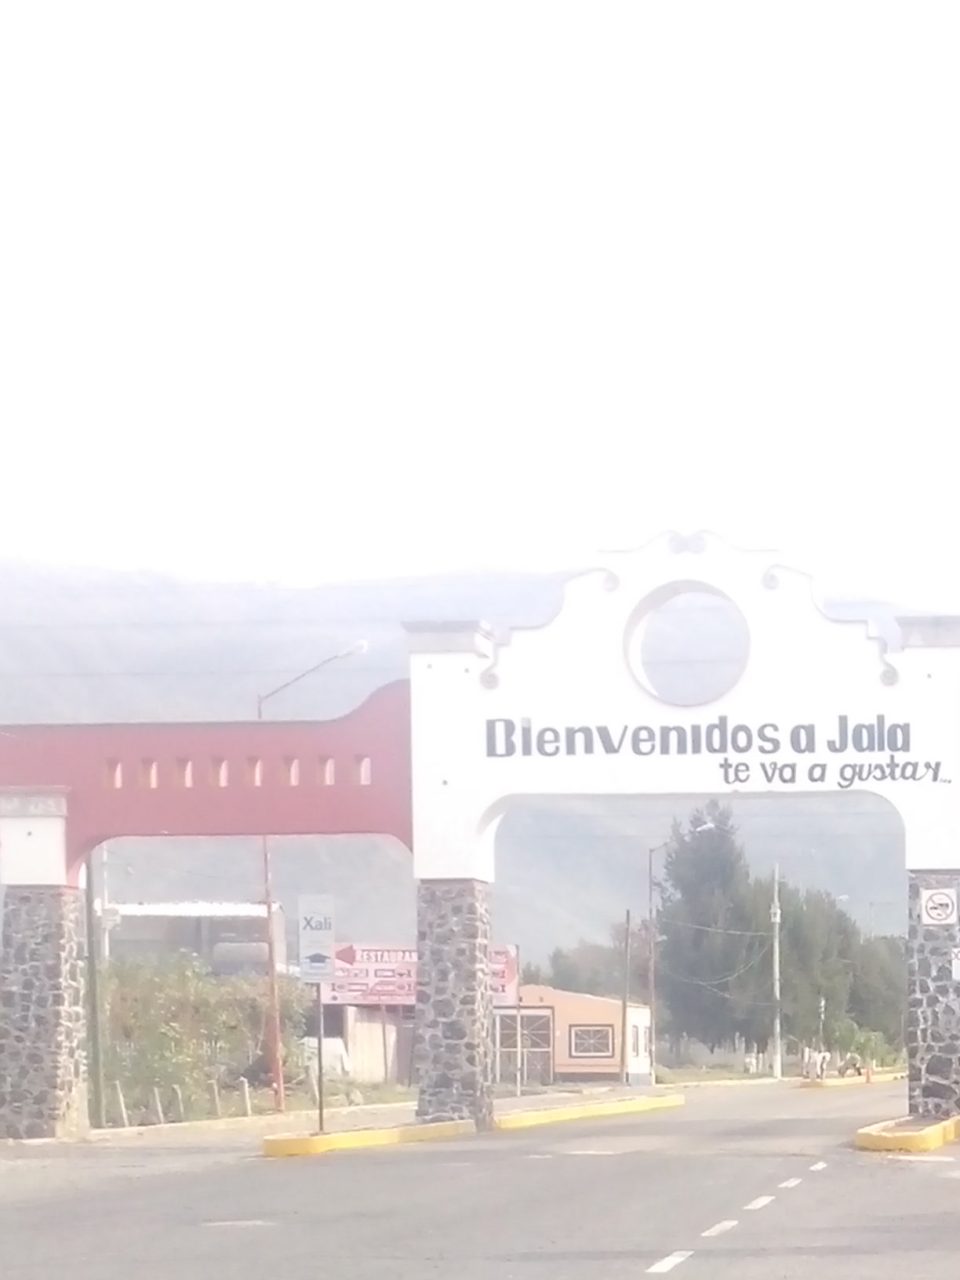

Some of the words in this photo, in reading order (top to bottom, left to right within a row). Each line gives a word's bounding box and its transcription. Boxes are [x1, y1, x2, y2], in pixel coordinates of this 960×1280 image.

[486, 715, 781, 758] Bienvenidos
[790, 723, 816, 755] a
[826, 714, 911, 753] Jala
[719, 757, 750, 785] te
[760, 761, 797, 784] va
[807, 763, 827, 783] a
[302, 916, 332, 931] Xali
